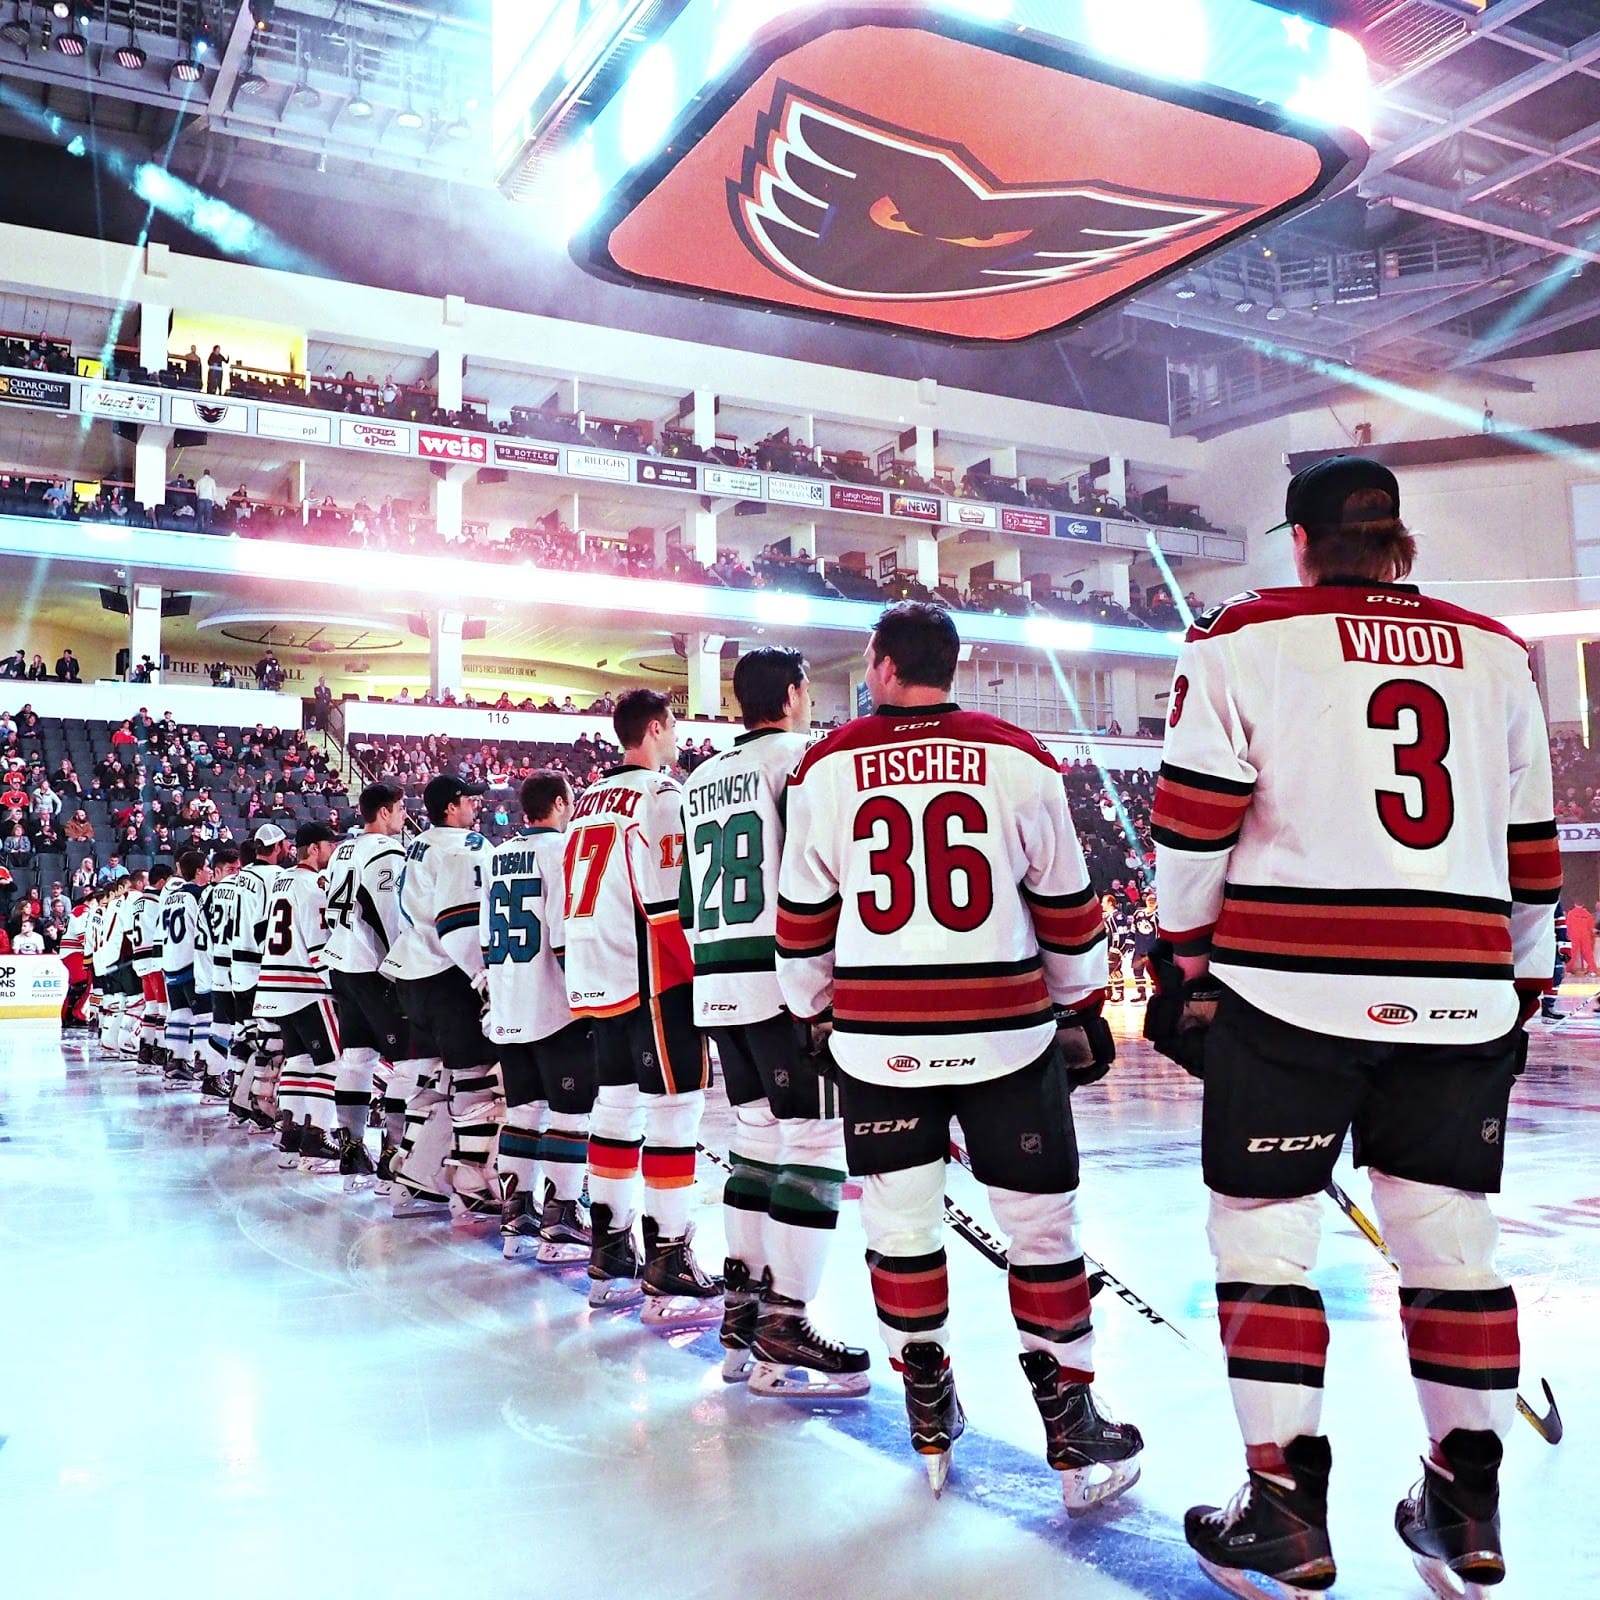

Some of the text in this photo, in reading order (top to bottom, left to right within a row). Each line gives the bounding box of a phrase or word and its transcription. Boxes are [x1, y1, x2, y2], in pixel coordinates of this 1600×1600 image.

[10, 378, 63, 393] CEDAR CREST
[10, 386, 45, 399] COLLEGE
[302, 426, 317, 436] ppl
[420, 436, 484, 459] weis
[499, 447, 511, 455] 99
[514, 449, 555, 461] BOTTLES
[861, 493, 881, 502] Carbon
[908, 501, 936, 514] NEWS
[1365, 594, 1421, 608] CCM
[1344, 619, 1455, 665] WOOD
[172, 661, 199, 674] THE
[1169, 674, 1190, 728] 3
[487, 712, 510, 725] 116
[893, 720, 941, 732] CCM
[1075, 745, 1091, 756] 118
[861, 745, 980, 789] FISCHER
[1366, 677, 1455, 851] 3
[1560, 828, 1600, 841] DA
[853, 790, 994, 936] 36
[563, 823, 617, 921] 17
[694, 810, 765, 933] 28
[487, 878, 542, 965] 65
[32, 980, 62, 988] ABE
[709, 1003, 738, 1012] CCM
[1376, 1007, 1478, 1021] AHL CCM
[892, 1057, 977, 1069] AHL CCM
[853, 1117, 921, 1136] CCM
[1246, 1132, 1337, 1153] CCM
